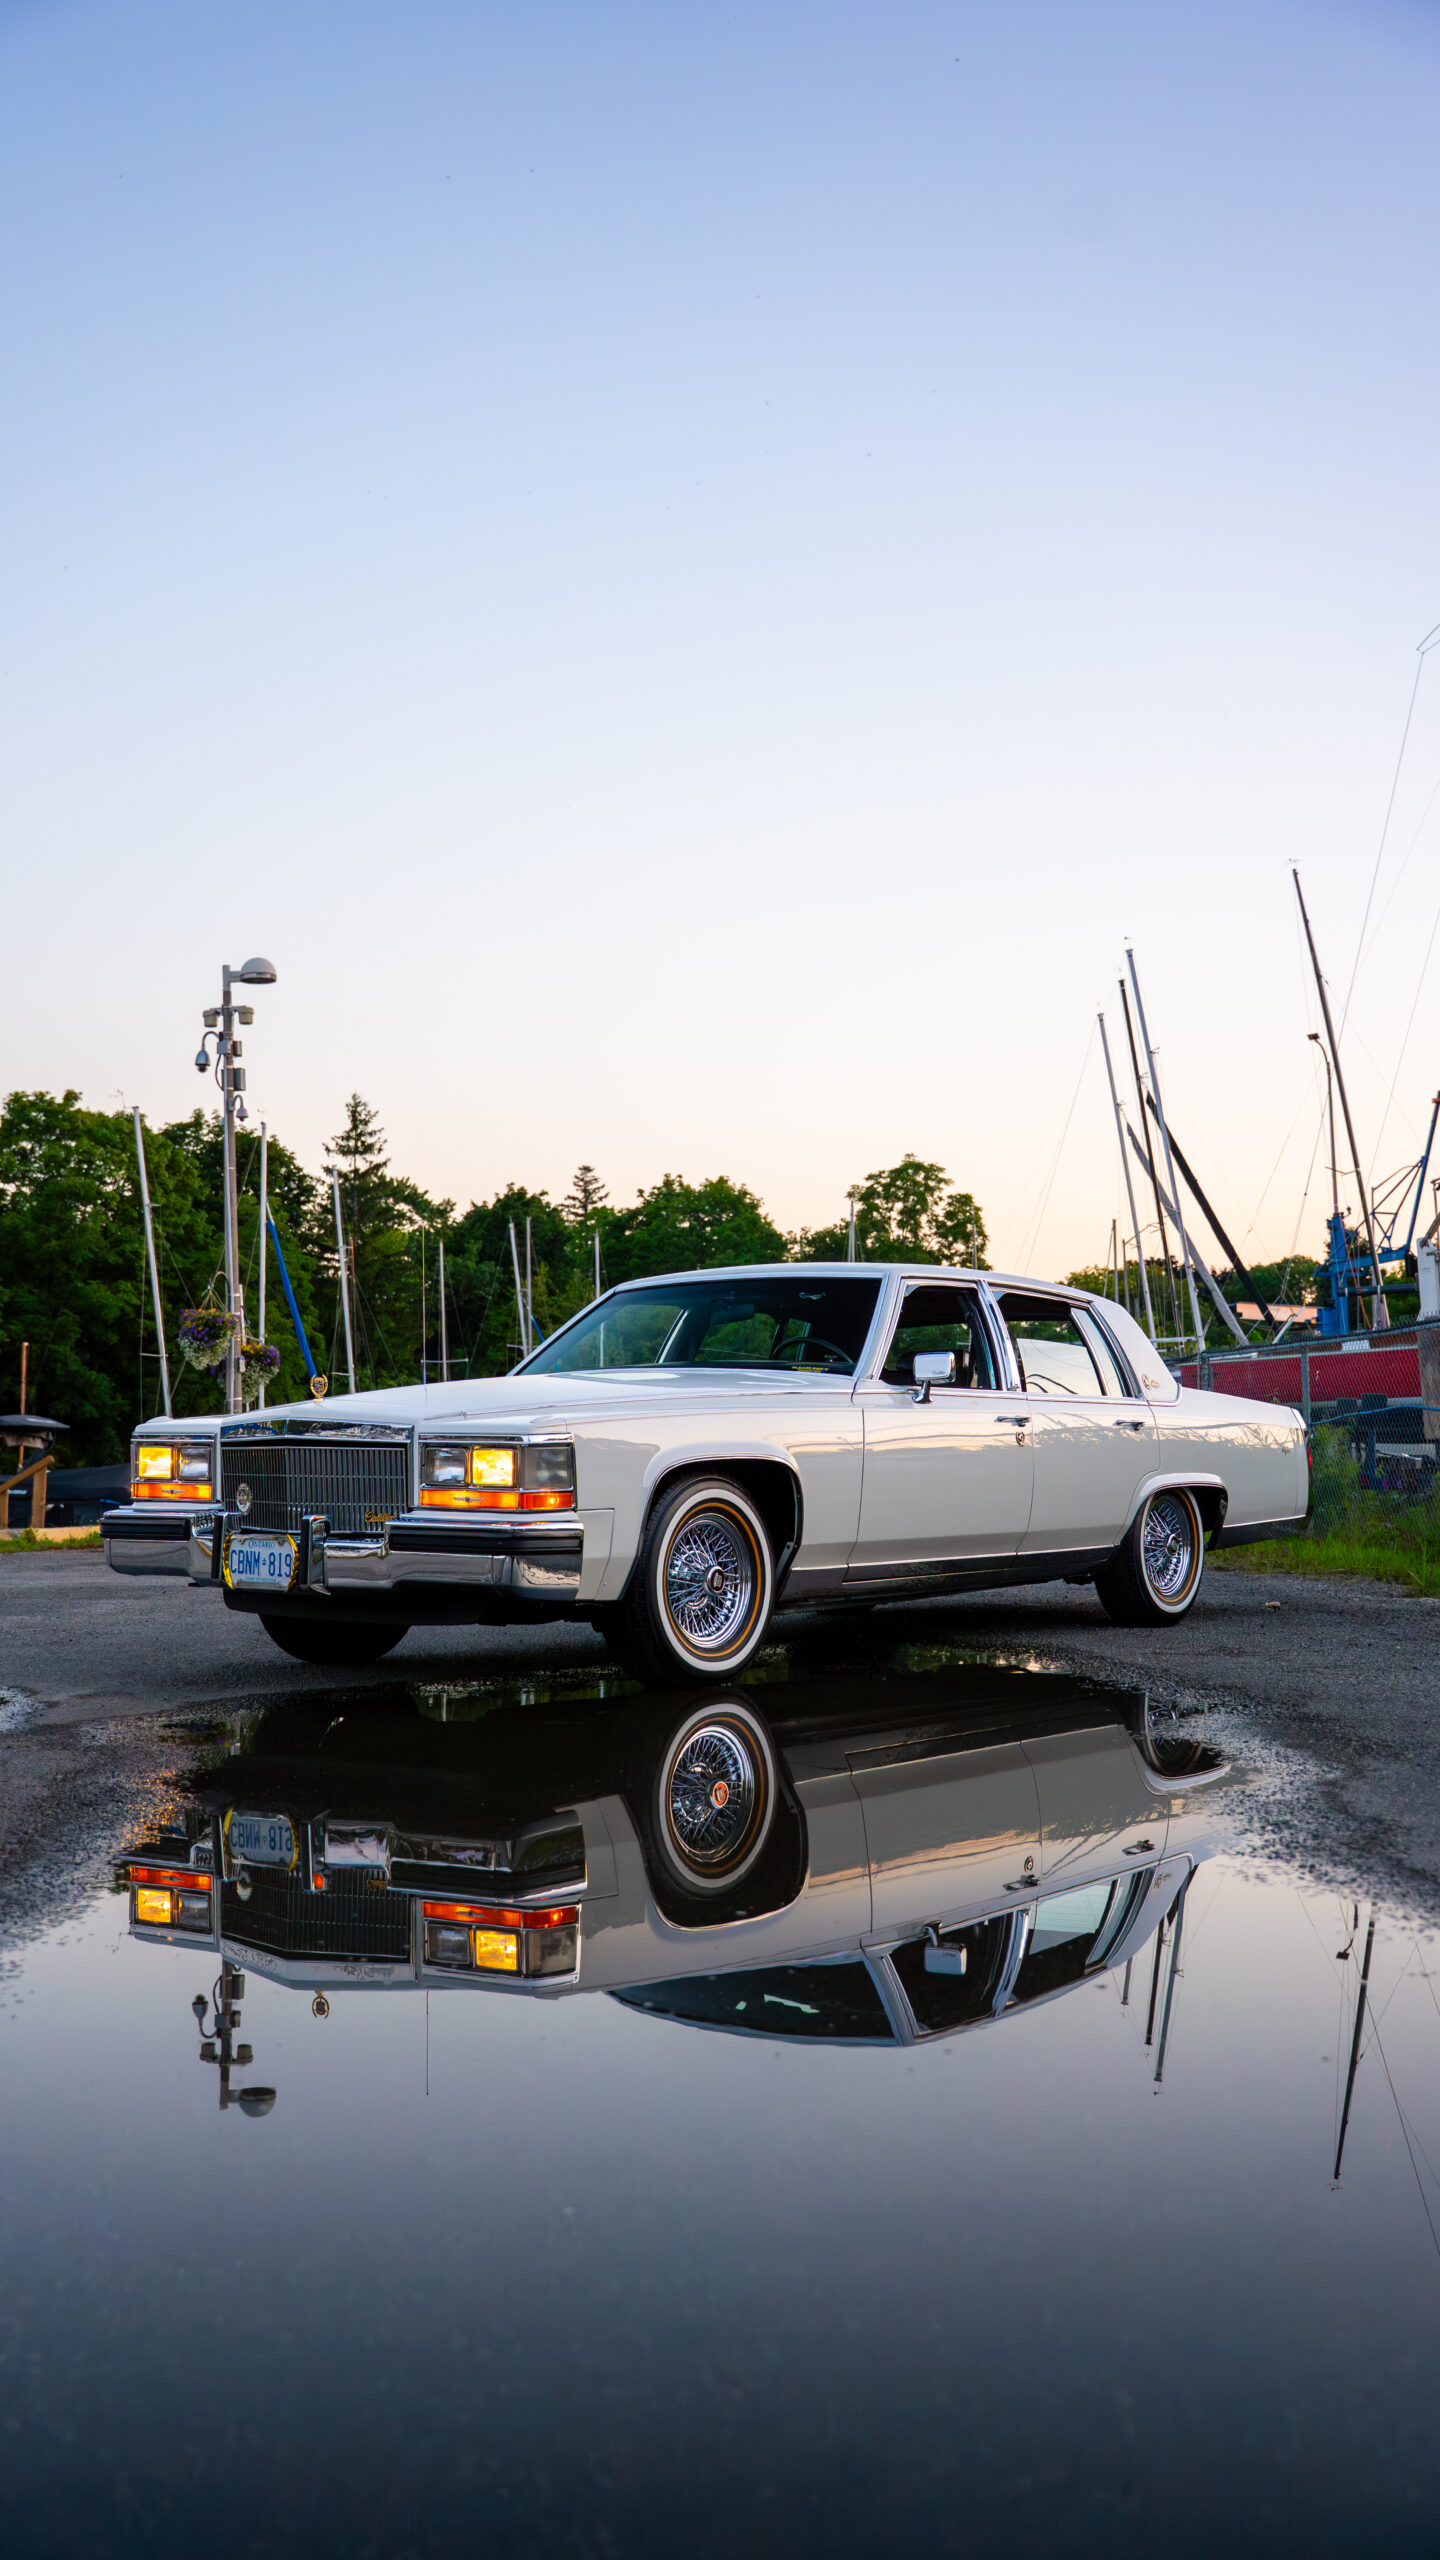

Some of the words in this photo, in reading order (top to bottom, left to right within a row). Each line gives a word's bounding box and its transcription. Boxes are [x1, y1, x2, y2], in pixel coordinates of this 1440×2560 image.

[248, 1540, 275, 1549] ONTARIO
[230, 1549, 260, 1576] CBNM
[268, 1552, 292, 1578] 819
